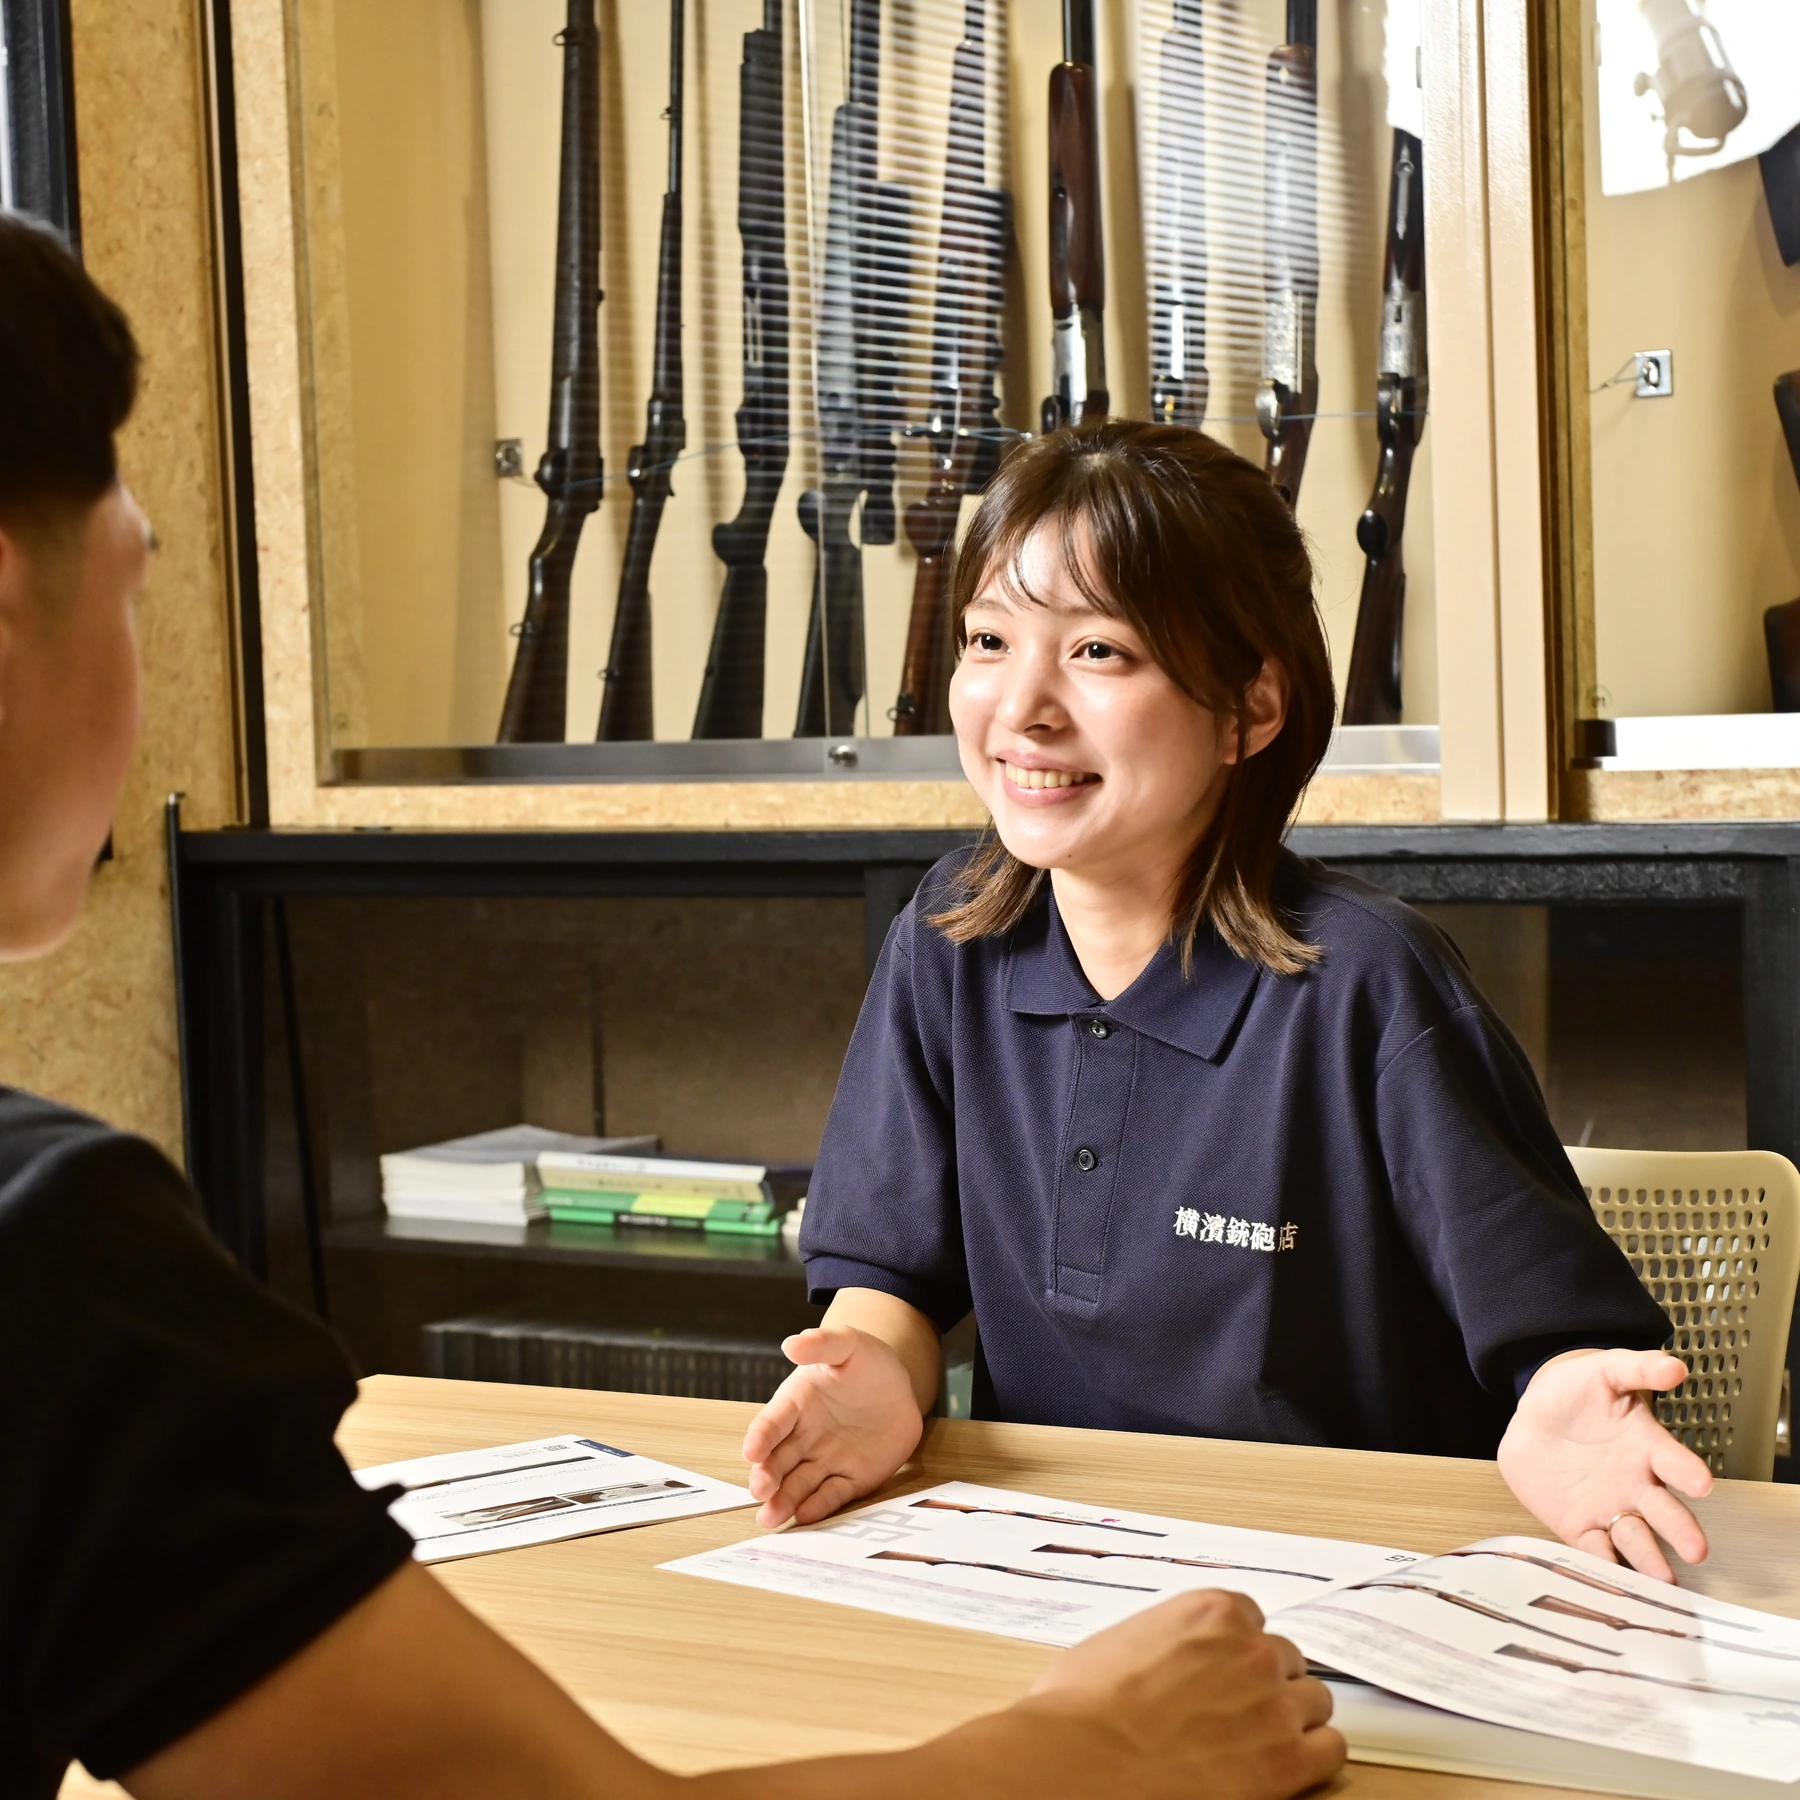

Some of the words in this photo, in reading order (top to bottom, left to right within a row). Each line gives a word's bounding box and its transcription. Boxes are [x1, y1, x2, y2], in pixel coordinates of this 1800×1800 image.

[1172, 1205, 1299, 1252] 横濱銃砲店
[1385, 1554, 1417, 1563] SP
